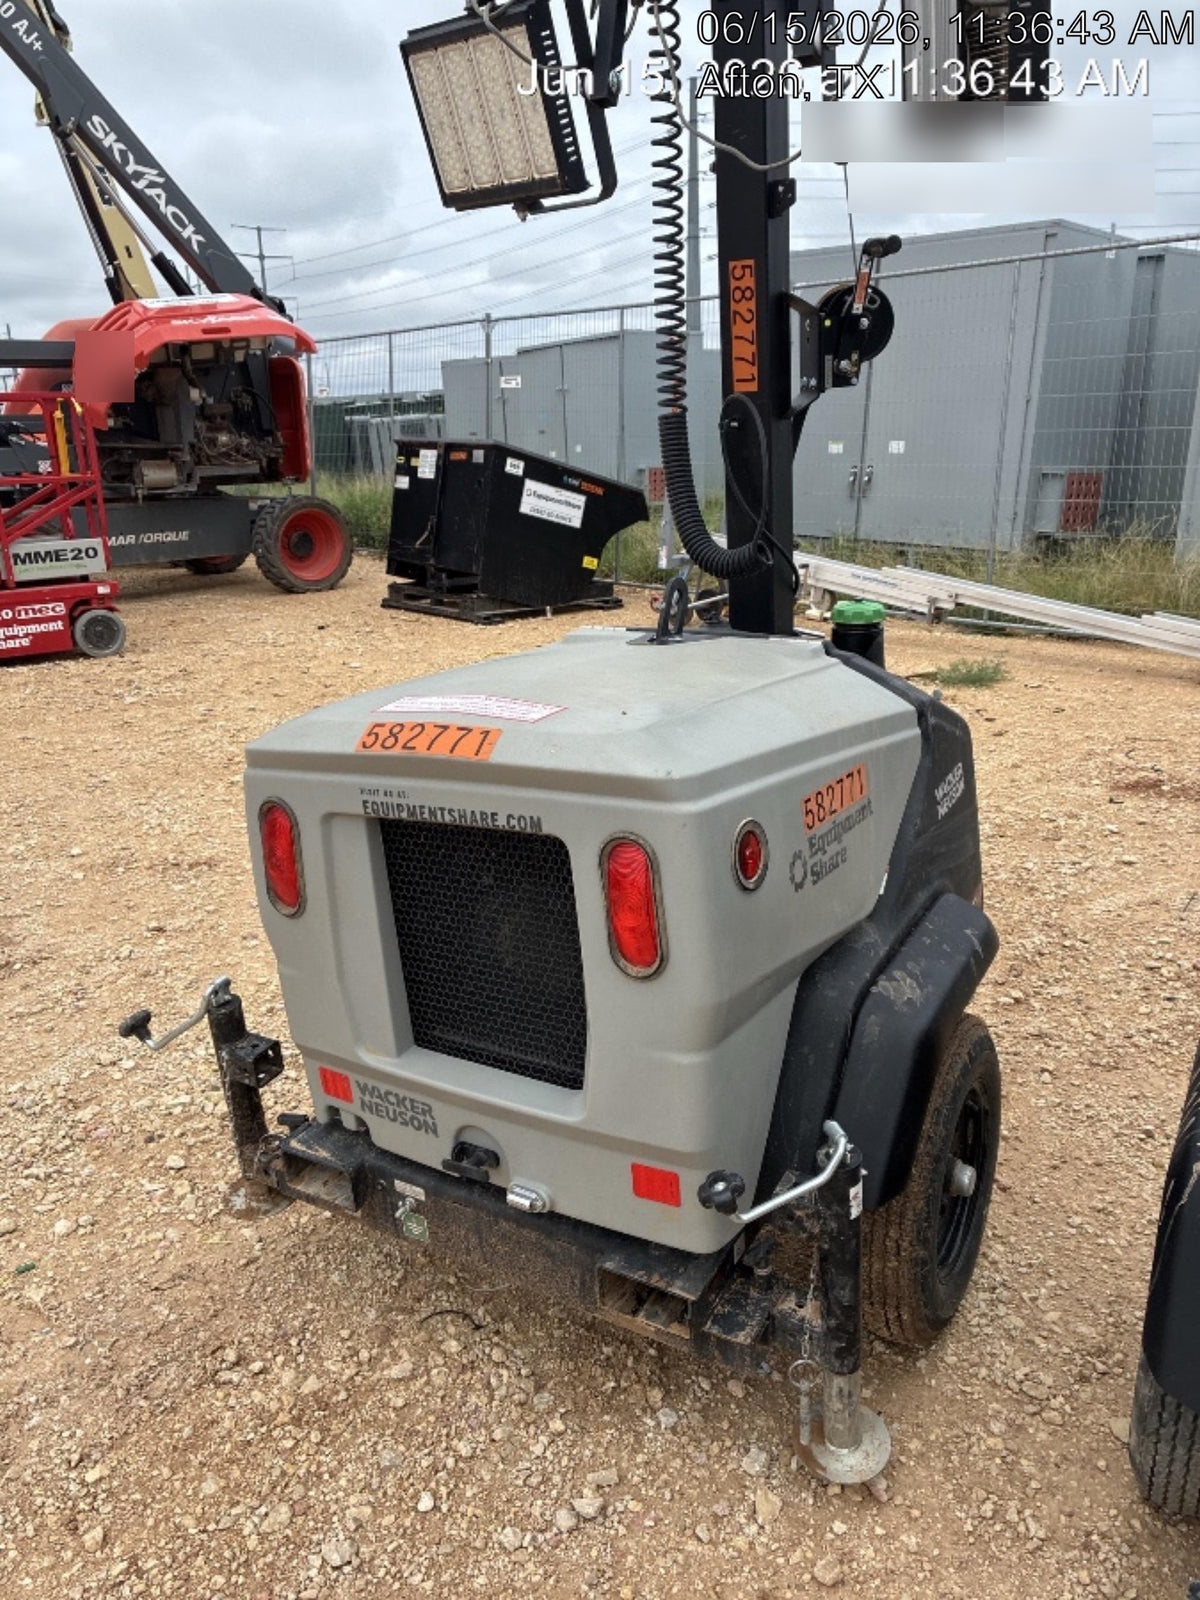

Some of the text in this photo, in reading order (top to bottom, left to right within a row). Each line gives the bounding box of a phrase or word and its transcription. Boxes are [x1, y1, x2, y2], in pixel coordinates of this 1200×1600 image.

[12, 19, 43, 51] AJ+
[86, 114, 207, 254] SKYJACK
[731, 264, 757, 384] 582771
[12, 546, 98, 567] MME20
[362, 723, 492, 757] 582771
[361, 799, 543, 832] EQUIPMENTSHARE.COM
[803, 767, 864, 831] 582771
[807, 798, 874, 860] Equipment
[809, 846, 848, 886] Share
[355, 1080, 436, 1121] WACKER
[359, 1096, 440, 1139] NEUSON
